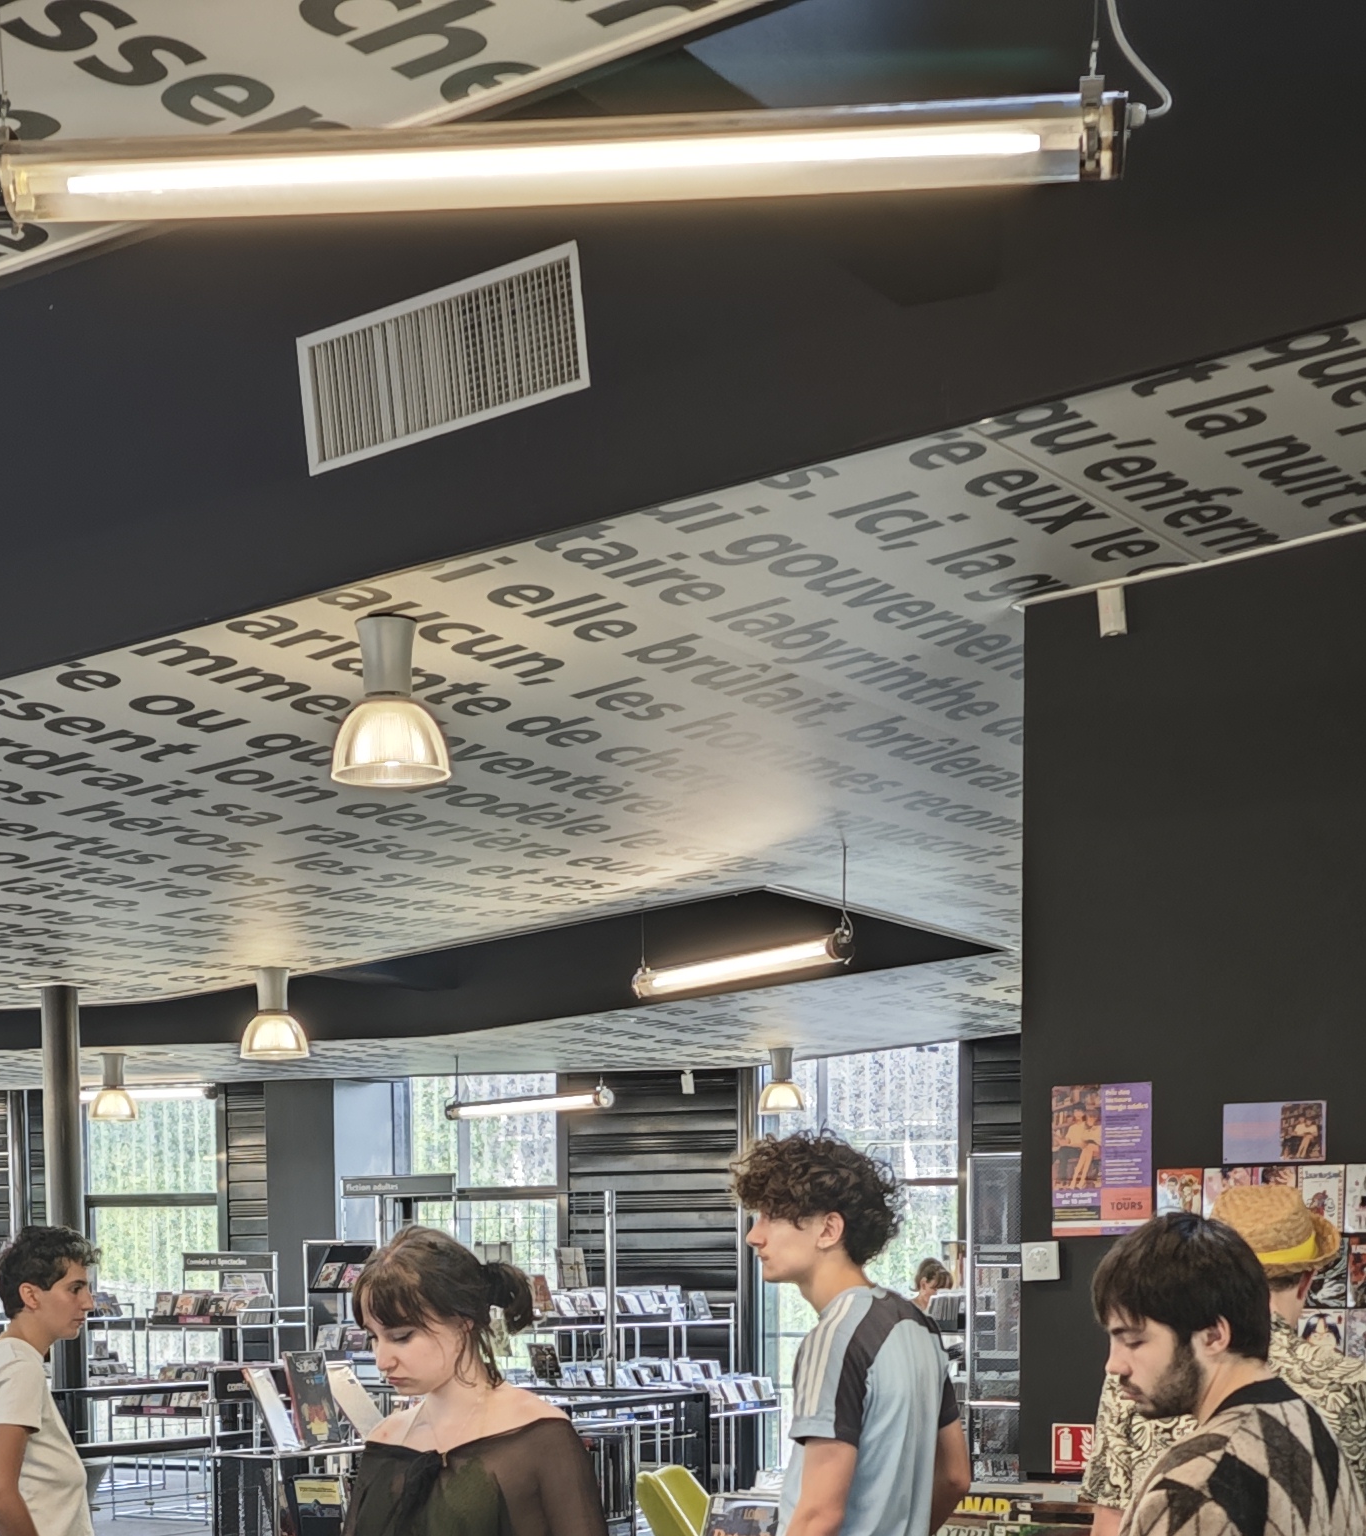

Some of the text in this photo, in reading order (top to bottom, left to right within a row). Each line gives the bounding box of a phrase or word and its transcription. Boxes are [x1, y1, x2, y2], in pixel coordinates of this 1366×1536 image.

[1166, 384, 1273, 441] la
[964, 463, 1160, 562] eux le
[925, 537, 1018, 580] la
[487, 581, 638, 642] elle
[708, 598, 1015, 722] labyrinthe
[129, 694, 252, 733] ou
[571, 676, 684, 722] les
[506, 714, 602, 750] de
[183, 756, 338, 804] loin
[335, 803, 573, 860] derrière
[58, 801, 263, 857] héros,
[272, 851, 374, 877] les
[190, 804, 283, 827] sa
[276, 824, 472, 869] raison
[168, 860, 286, 887] des
[346, 1182, 398, 1191] fiction adultes
[1110, 1201, 1143, 1211] TOURS
